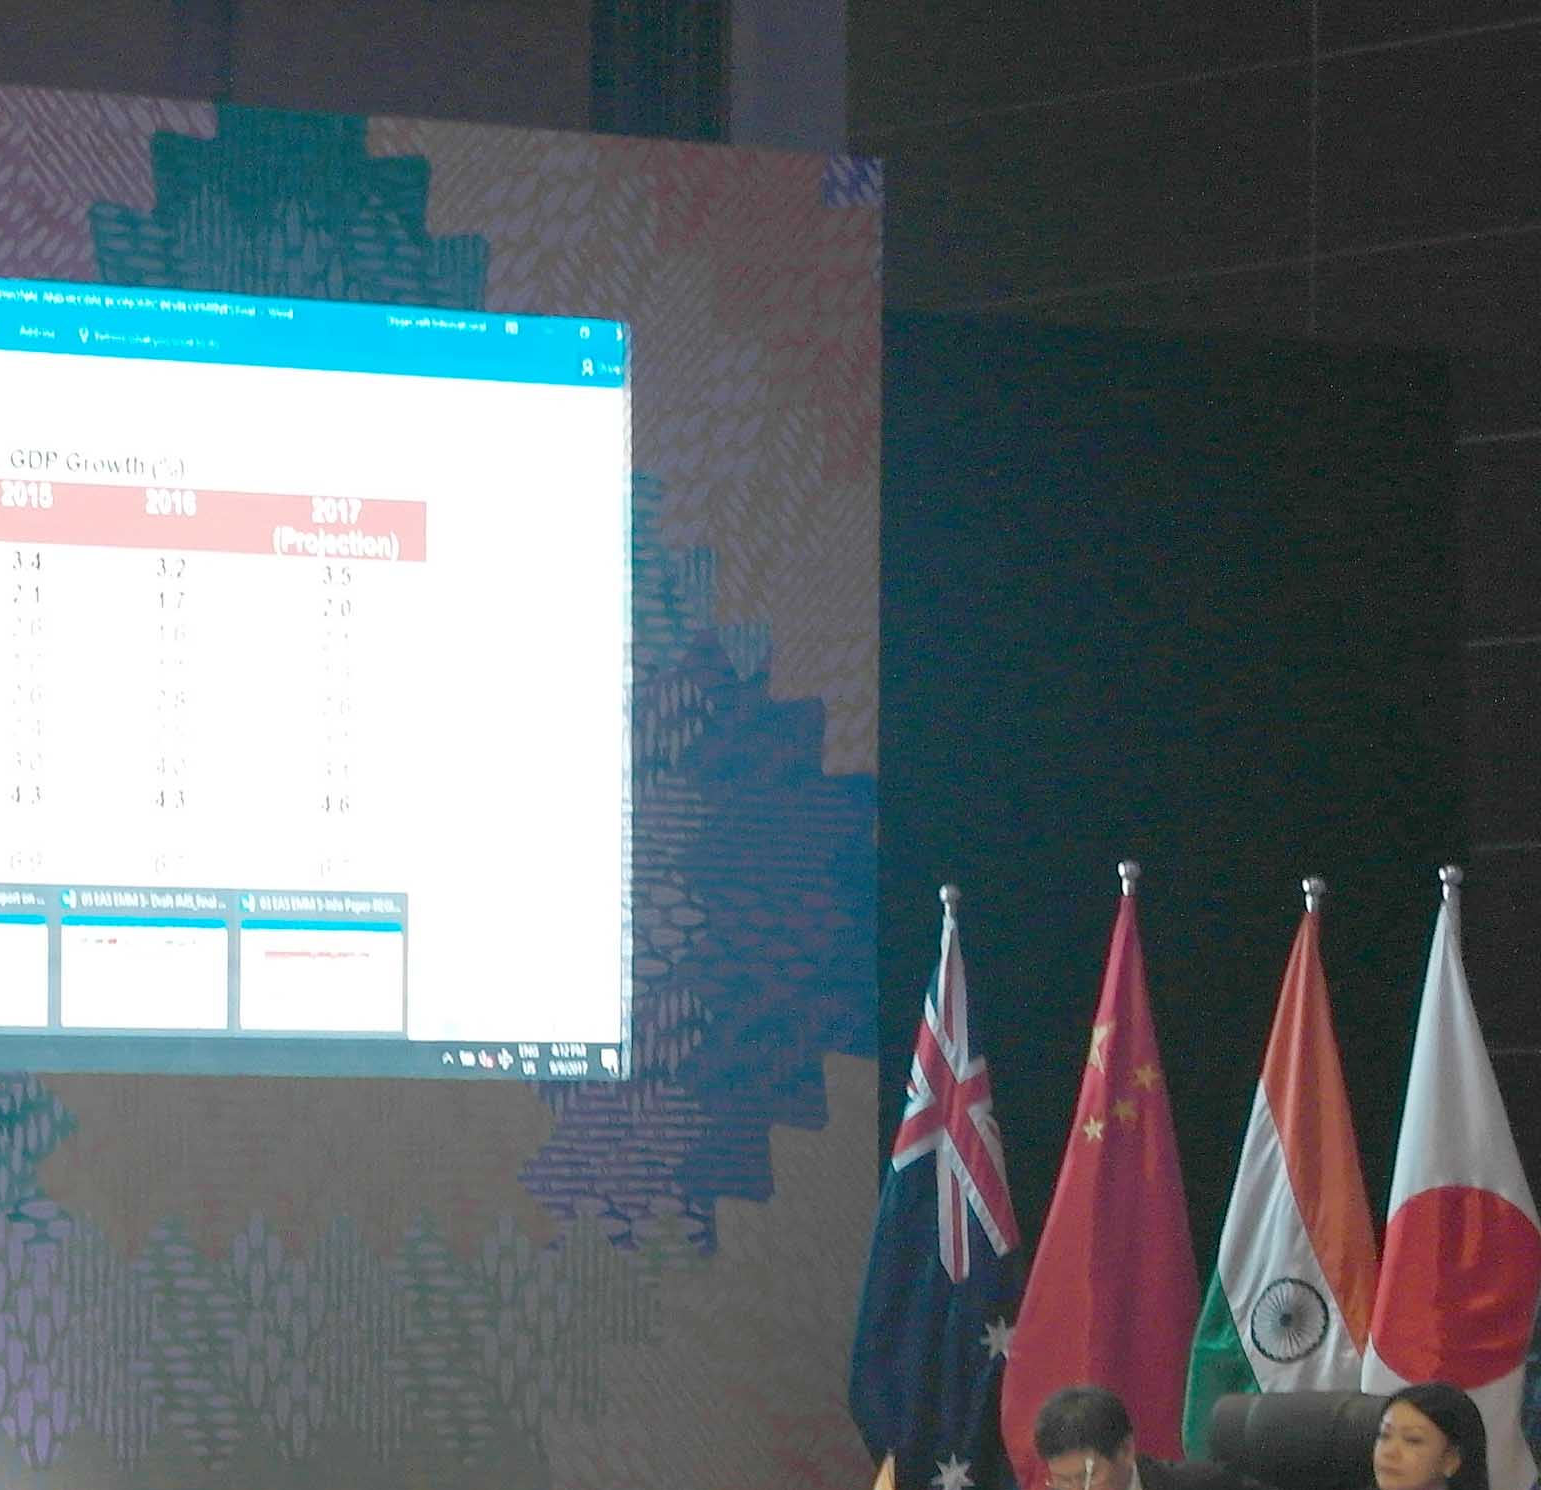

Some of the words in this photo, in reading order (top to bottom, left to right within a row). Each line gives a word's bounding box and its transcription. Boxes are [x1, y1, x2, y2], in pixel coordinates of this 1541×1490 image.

[9, 449, 59, 471] GDP
[65, 452, 145, 475] Growth
[311, 496, 363, 524] 2017
[272, 526, 401, 561] (Projection)
